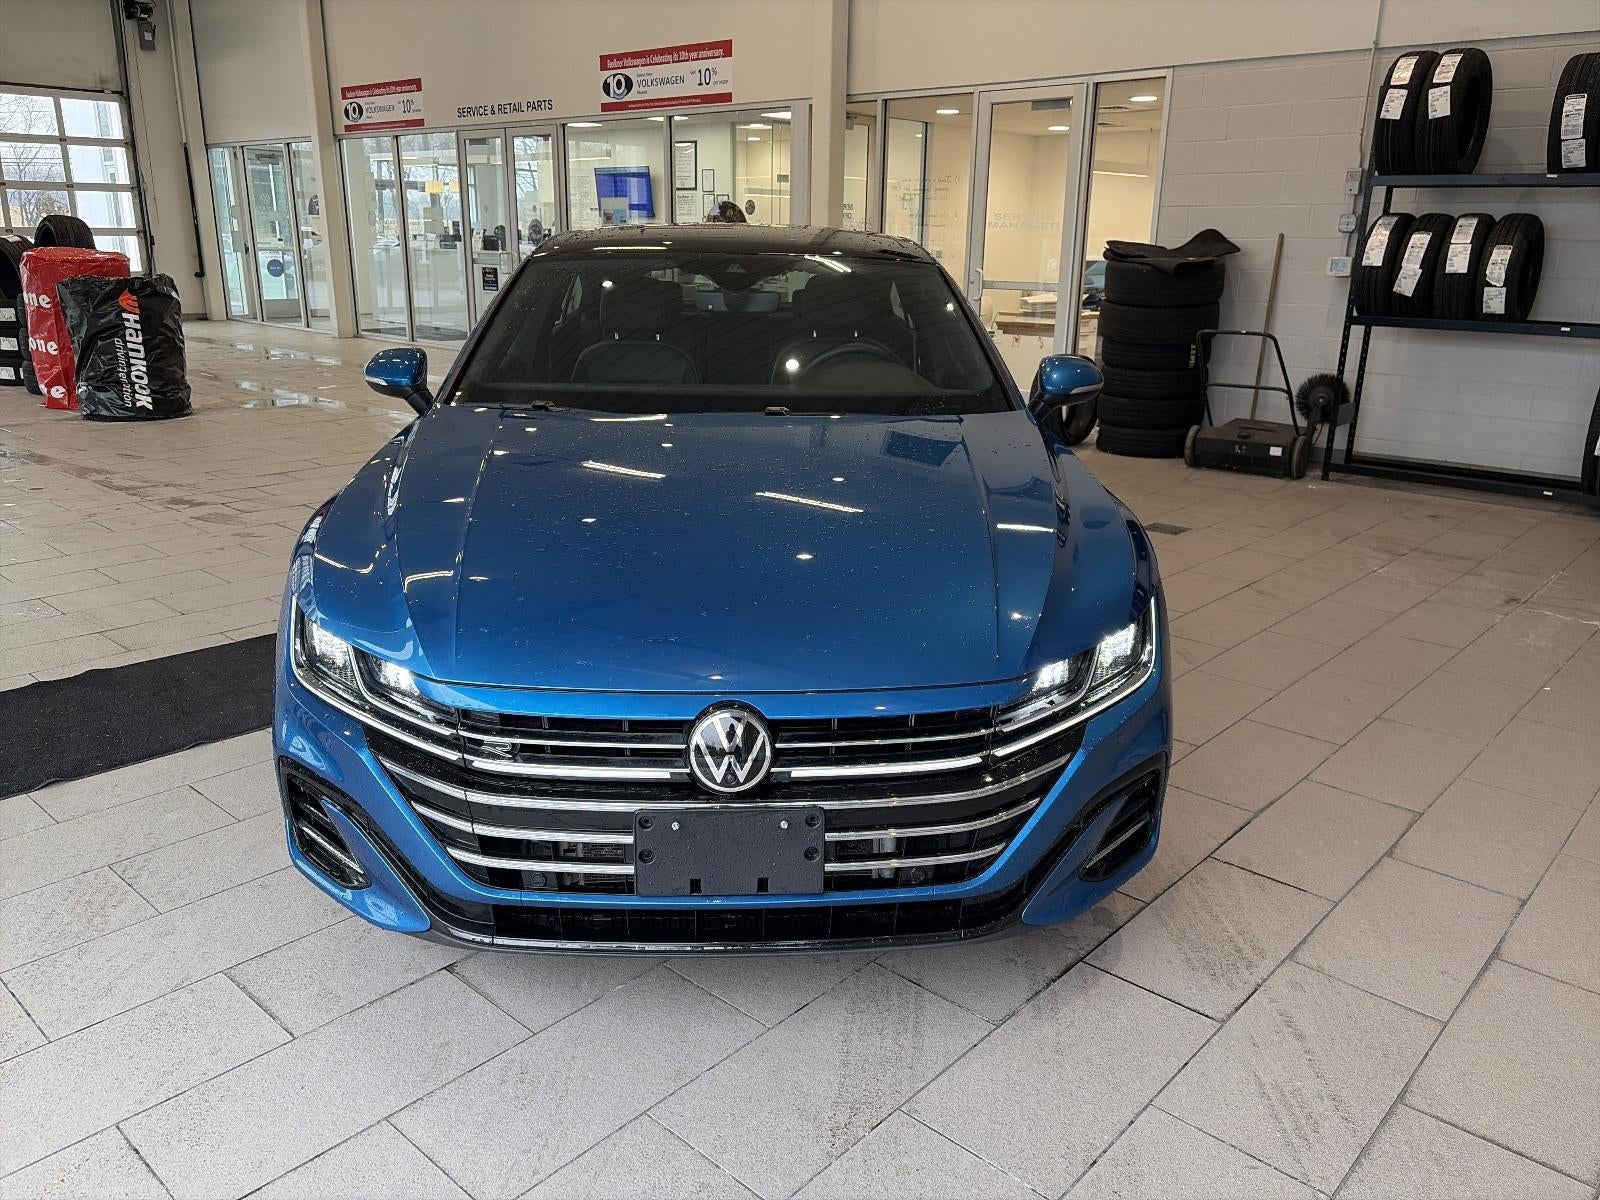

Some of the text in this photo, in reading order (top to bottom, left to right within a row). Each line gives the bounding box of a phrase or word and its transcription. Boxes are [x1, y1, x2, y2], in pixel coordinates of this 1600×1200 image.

[650, 53, 672, 64] Celebrating
[689, 51, 698, 61] year
[636, 75, 685, 88] VOLKSWAGEN
[457, 98, 553, 118] SERVICE & RETAIL PARTS
[114, 337, 128, 373] driving
[121, 312, 154, 411] Hankook
